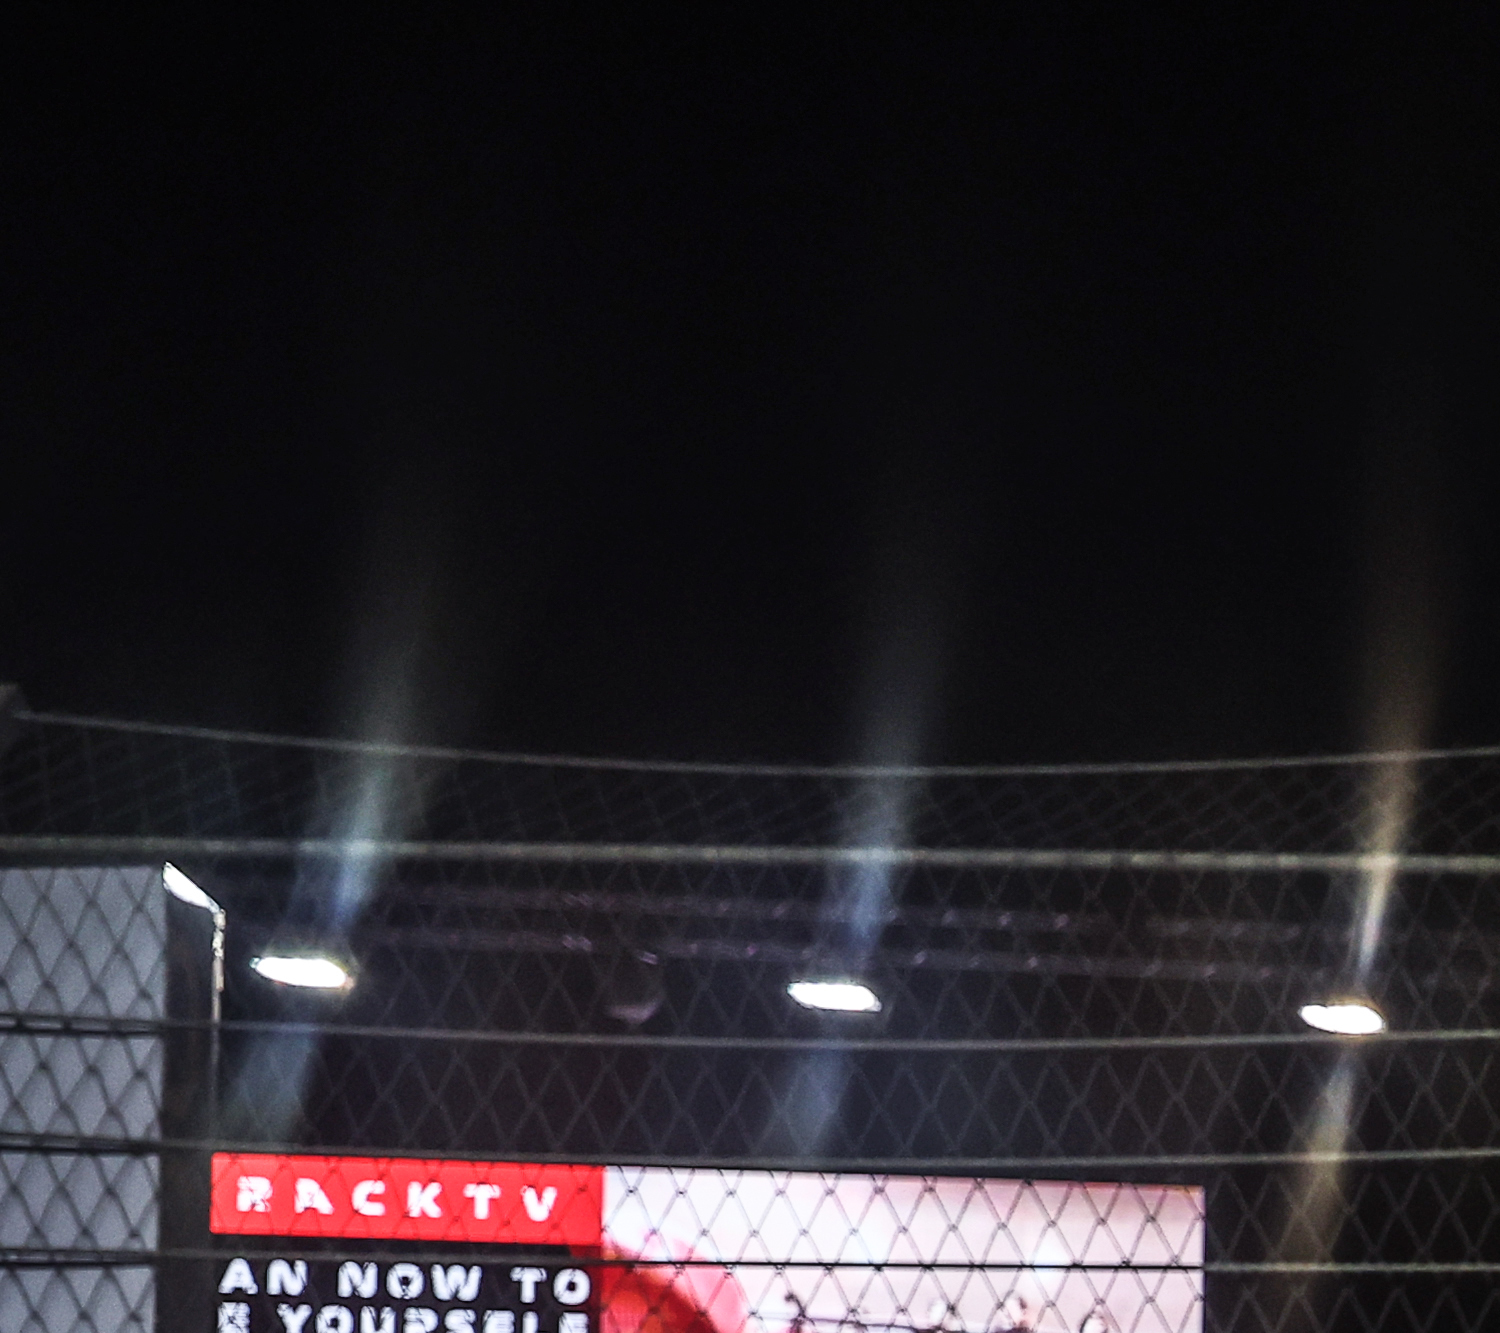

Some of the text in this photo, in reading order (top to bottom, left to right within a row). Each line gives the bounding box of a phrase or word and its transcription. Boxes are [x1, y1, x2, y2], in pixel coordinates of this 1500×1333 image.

[236, 1175, 558, 1222] RACKTV
[217, 1257, 592, 1306] AN NOW TO
